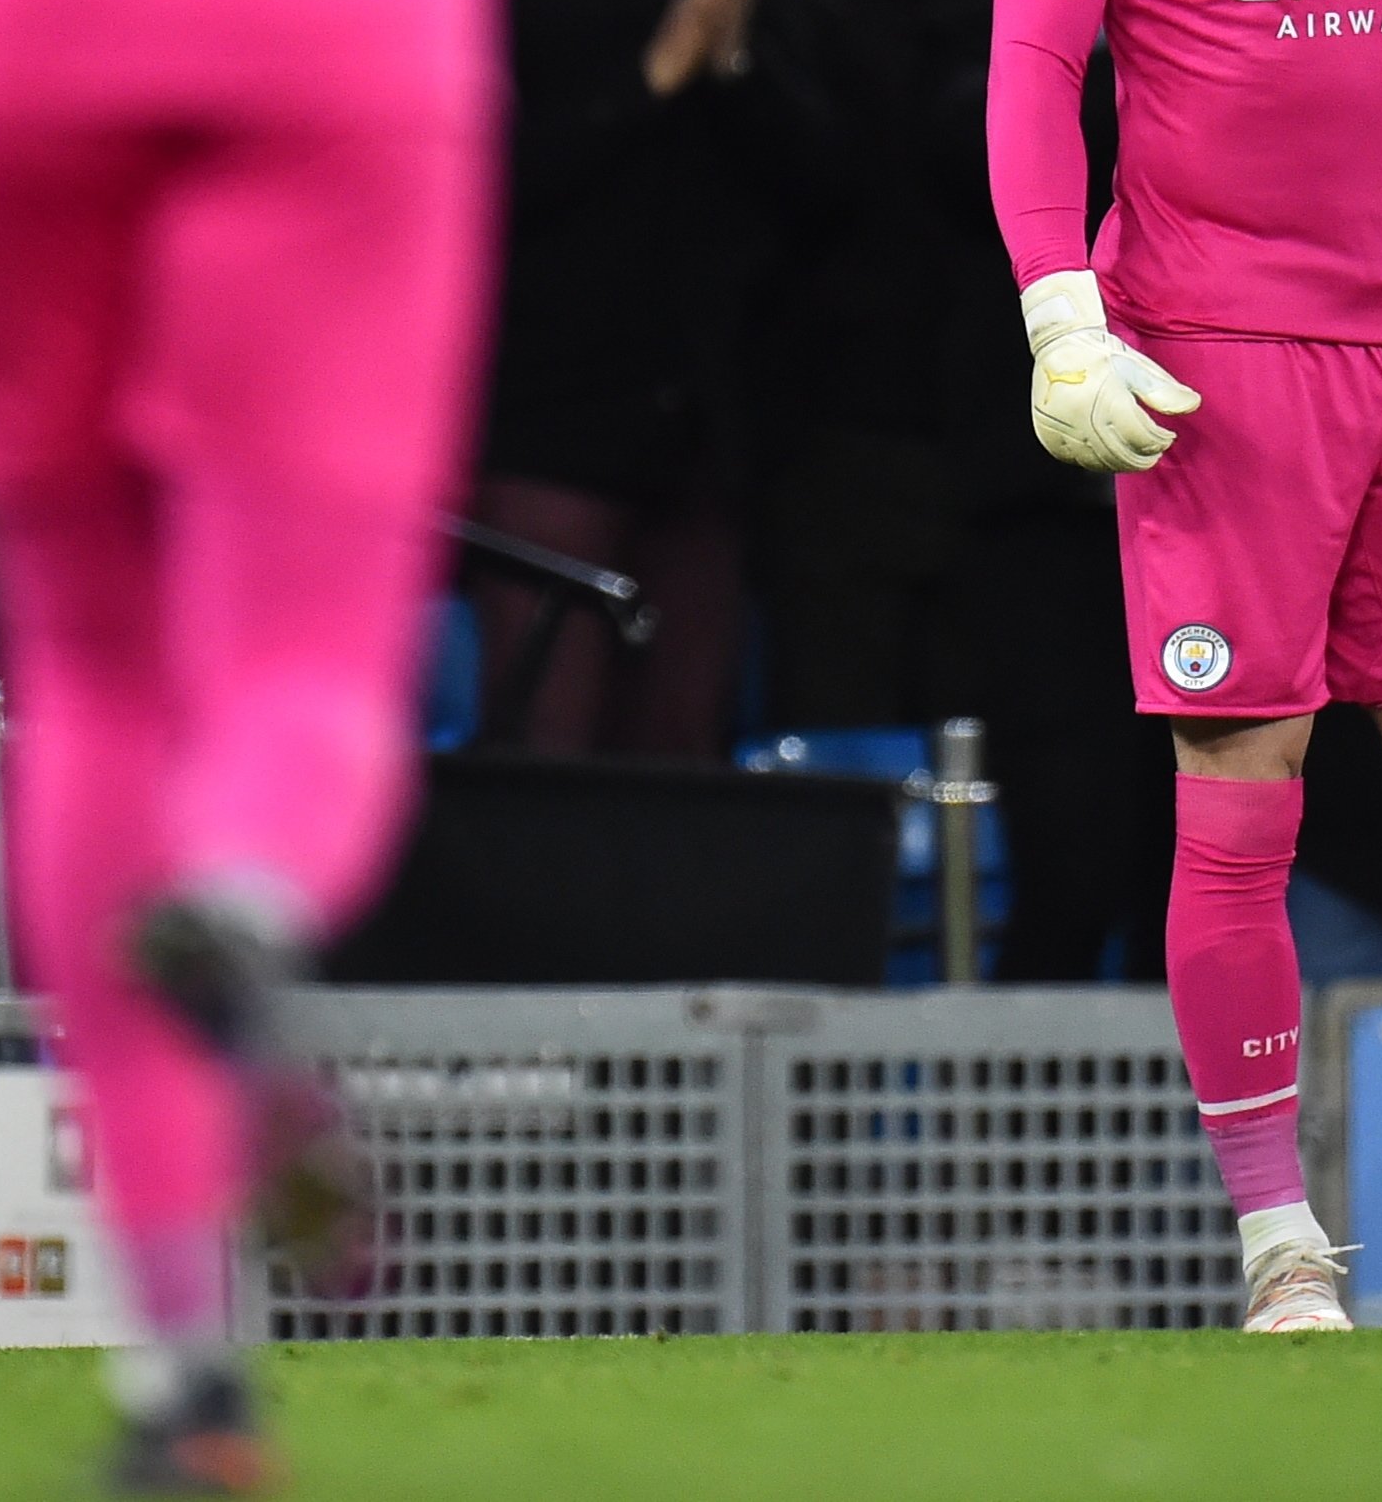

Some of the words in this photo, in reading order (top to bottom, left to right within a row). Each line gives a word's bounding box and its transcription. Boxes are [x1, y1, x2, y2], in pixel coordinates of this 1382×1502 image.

[1170, 627, 1225, 650] MANCHESTER
[1183, 679, 1205, 687] CITY
[1242, 1025, 1299, 1058] CITY
